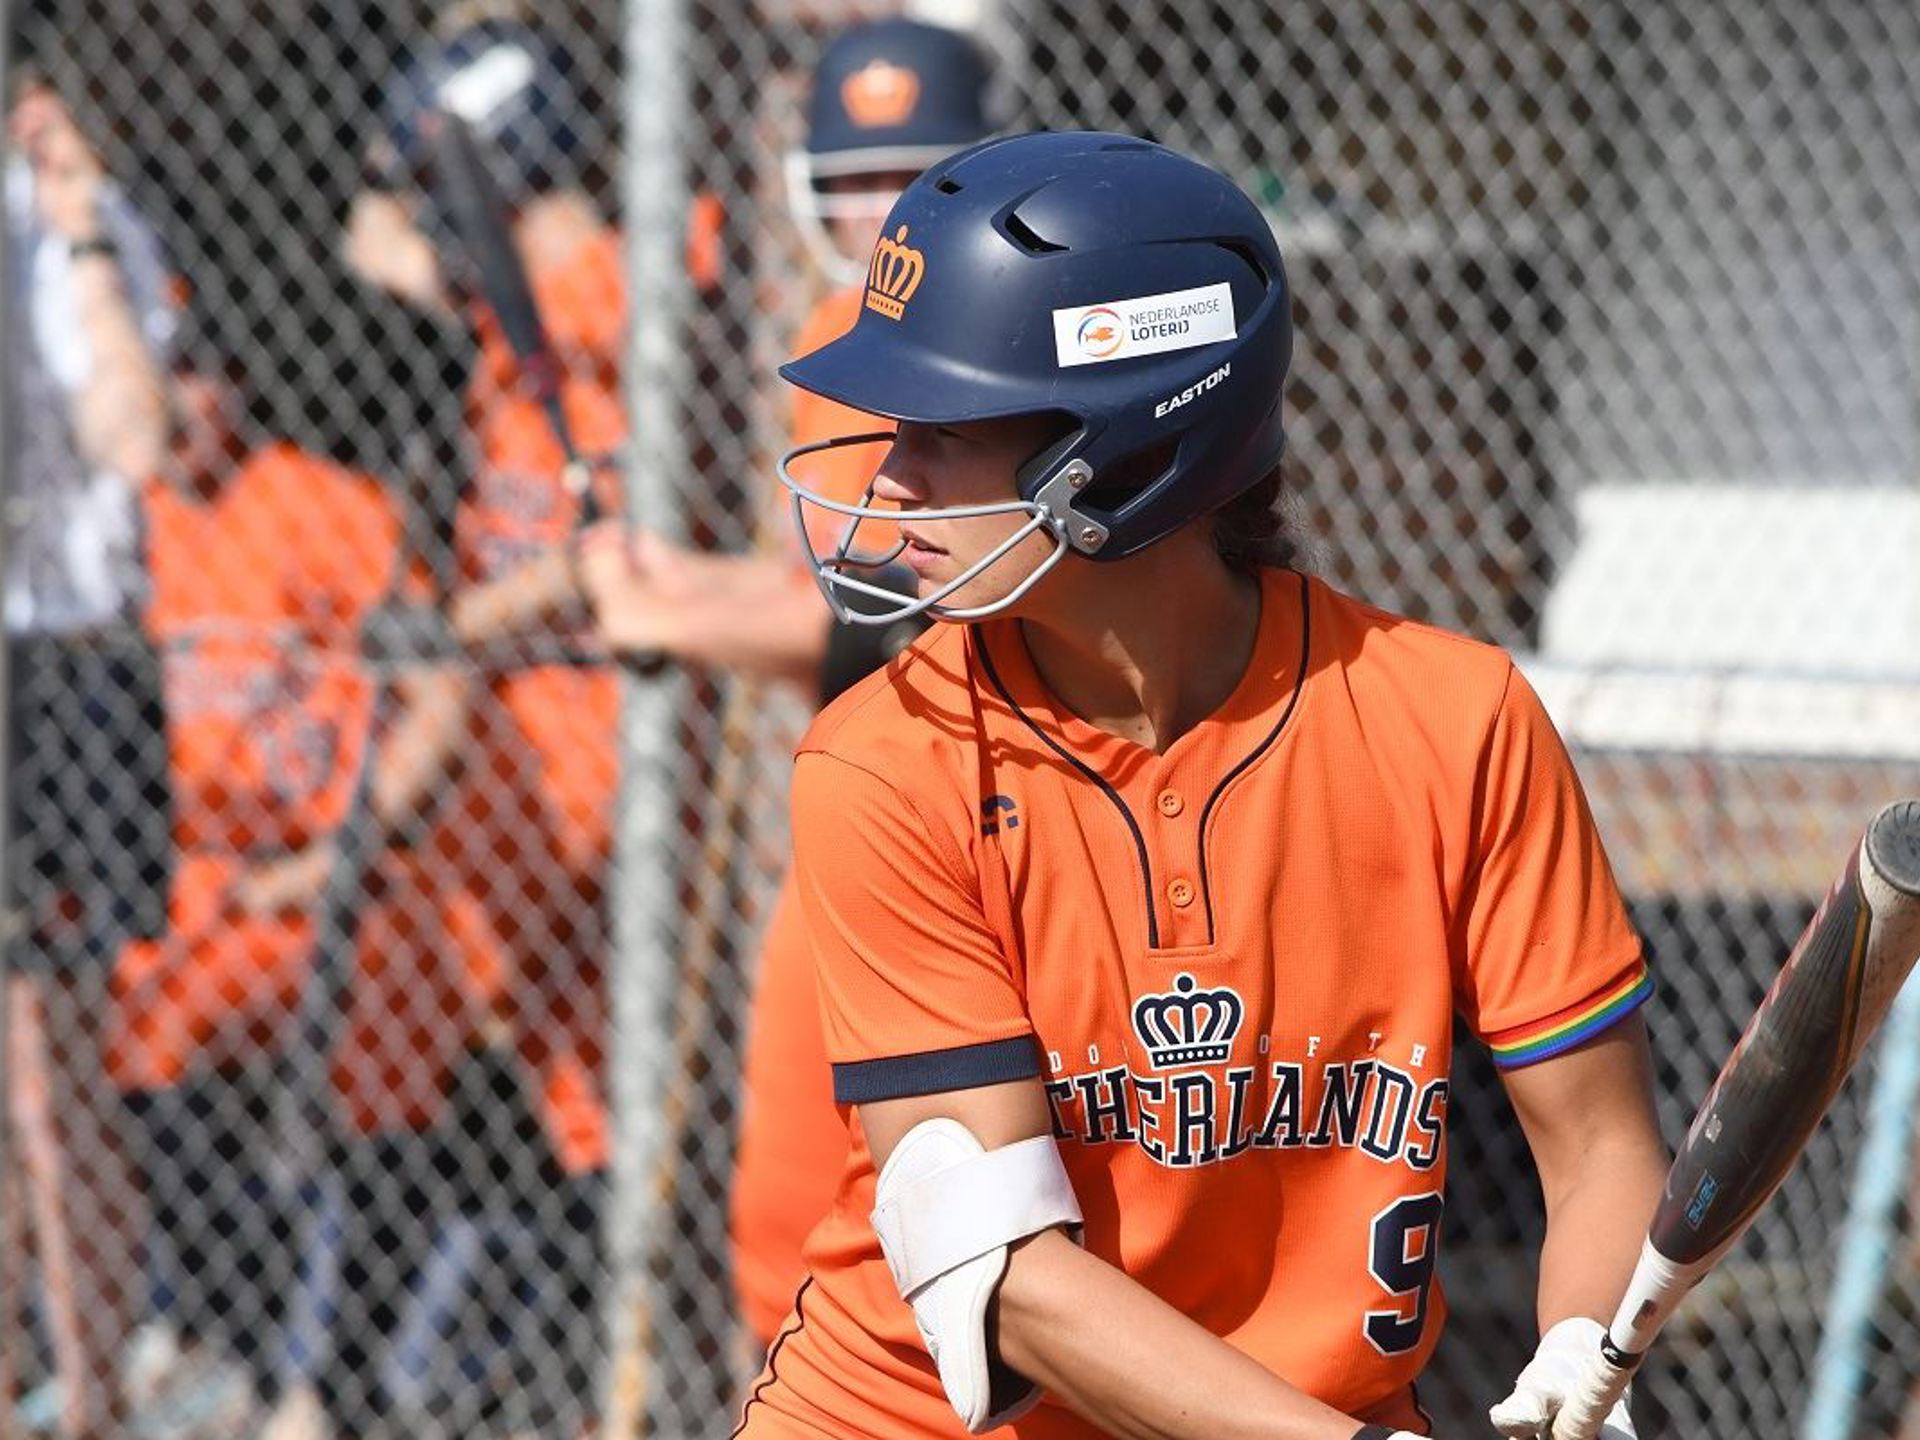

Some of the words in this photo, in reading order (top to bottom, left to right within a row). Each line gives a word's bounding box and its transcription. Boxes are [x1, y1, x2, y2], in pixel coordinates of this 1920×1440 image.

[1129, 298, 1221, 326] NEDERLANDSE
[1131, 320, 1190, 342] LOTERIJ
[1154, 362, 1231, 418] EASTON
[1363, 1192, 1444, 1358] 9
